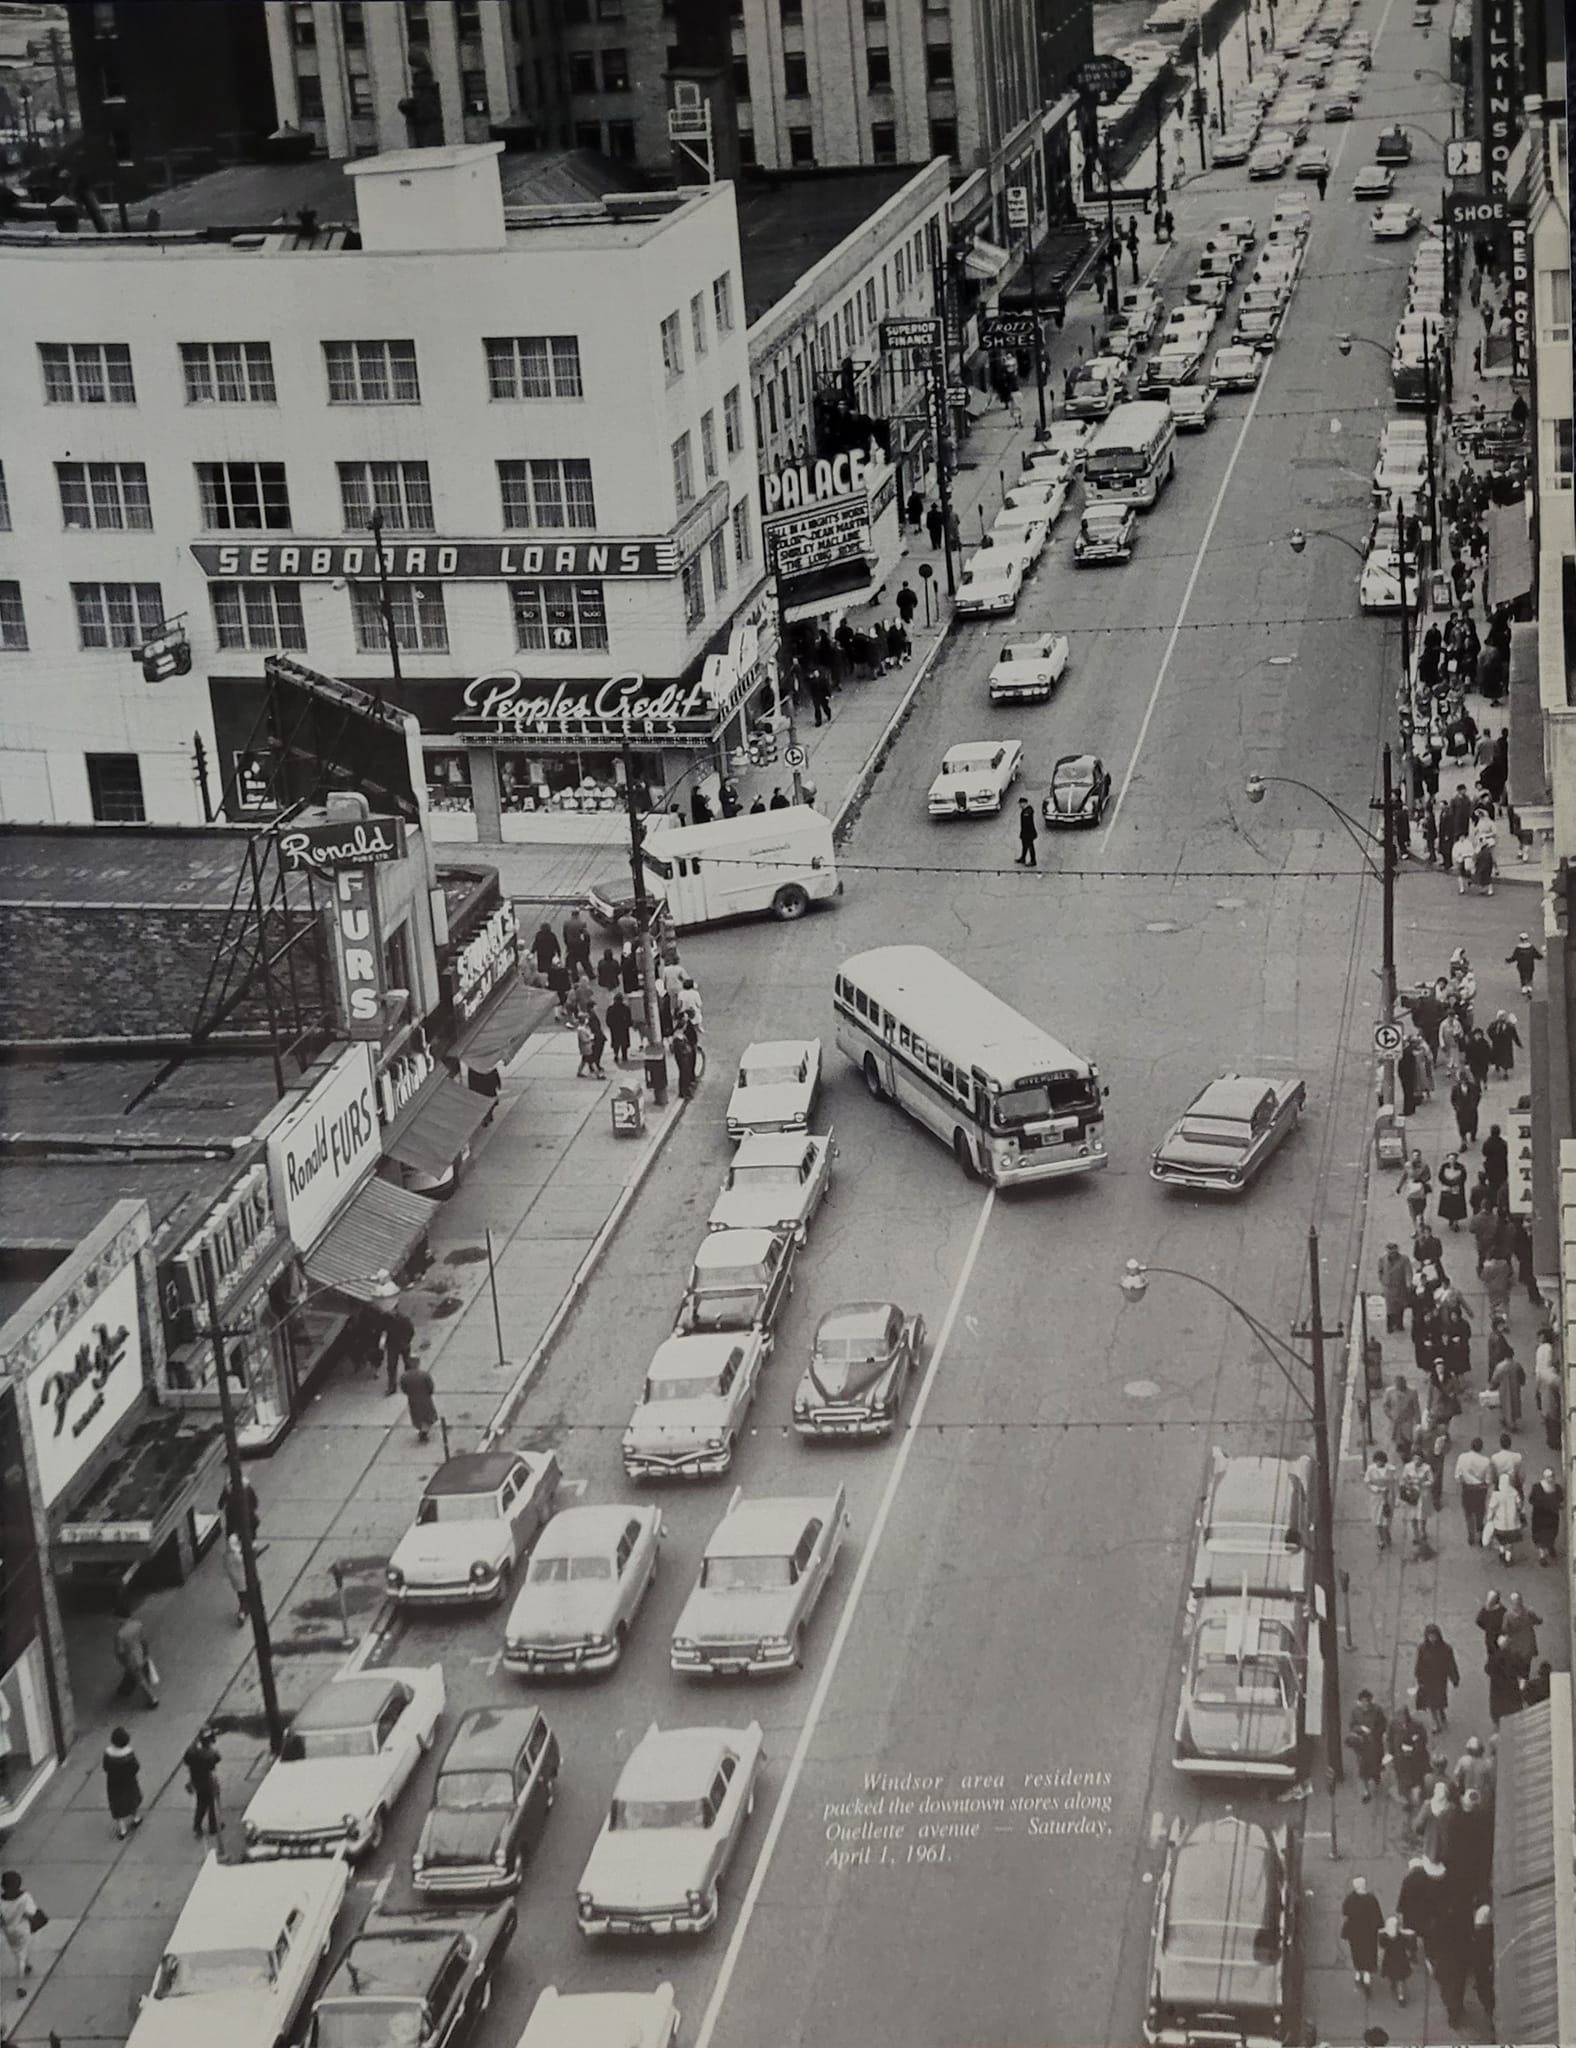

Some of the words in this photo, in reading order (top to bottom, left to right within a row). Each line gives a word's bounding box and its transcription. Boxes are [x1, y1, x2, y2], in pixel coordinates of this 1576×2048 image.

[1513, 230, 1527, 280] RED
[885, 322, 936, 337] SUPERIOR
[888, 334, 933, 347] FINANCE
[764, 448, 865, 513] PALACE
[218, 546, 458, 575] SEABOARD
[500, 545, 641, 573] LOANS
[464, 669, 592, 725] Peoples
[594, 671, 702, 718] Credit
[496, 719, 677, 734] JEWELLERS
[280, 825, 394, 869] Ronald
[338, 870, 377, 1019] FURS
[287, 1115, 328, 1201] Ronald
[331, 1087, 372, 1178] FURS
[1518, 1125, 1532, 1202] BATA
